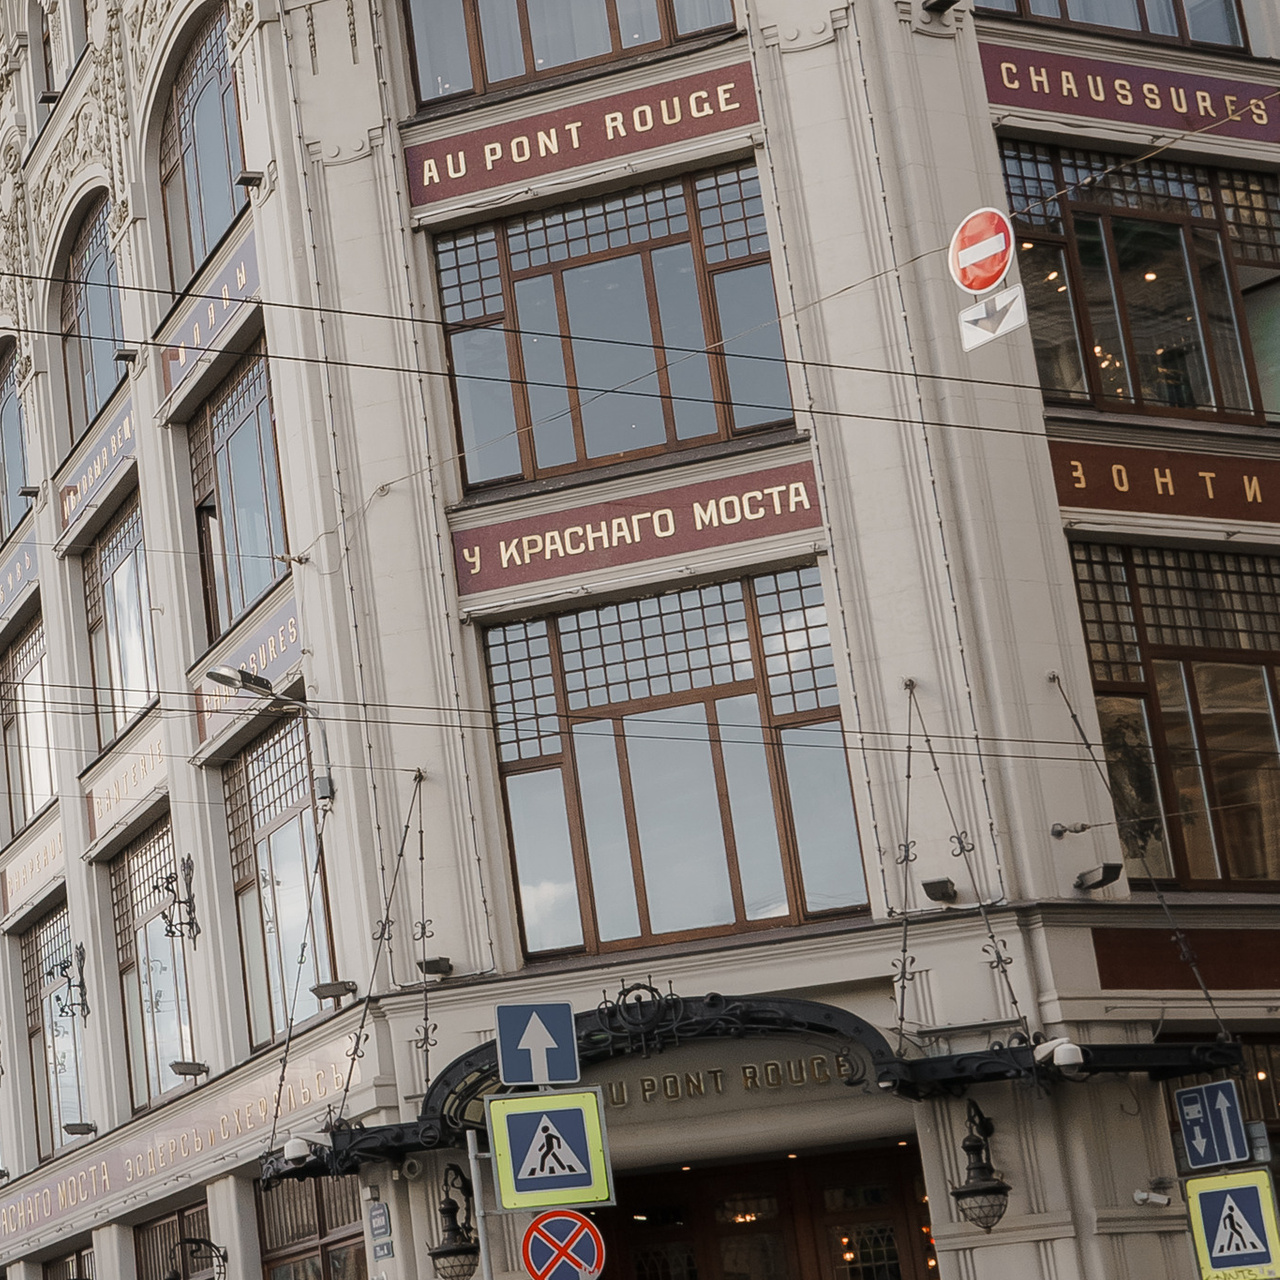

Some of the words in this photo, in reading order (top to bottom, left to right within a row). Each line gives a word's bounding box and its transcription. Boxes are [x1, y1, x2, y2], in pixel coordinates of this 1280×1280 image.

[1000, 62, 1269, 126] CHAUSSURES
[422, 151, 466, 187] AU
[483, 121, 582, 171] PONT
[604, 82, 741, 141] ROUGE
[463, 546, 481, 575] У
[499, 508, 676, 569] КРАСНАГО
[692, 481, 812, 532] МОСТА
[640, 1068, 724, 1103] PONT
[741, 1054, 852, 1091] ROUGE
[57, 1160, 110, 1211] МОСТА
